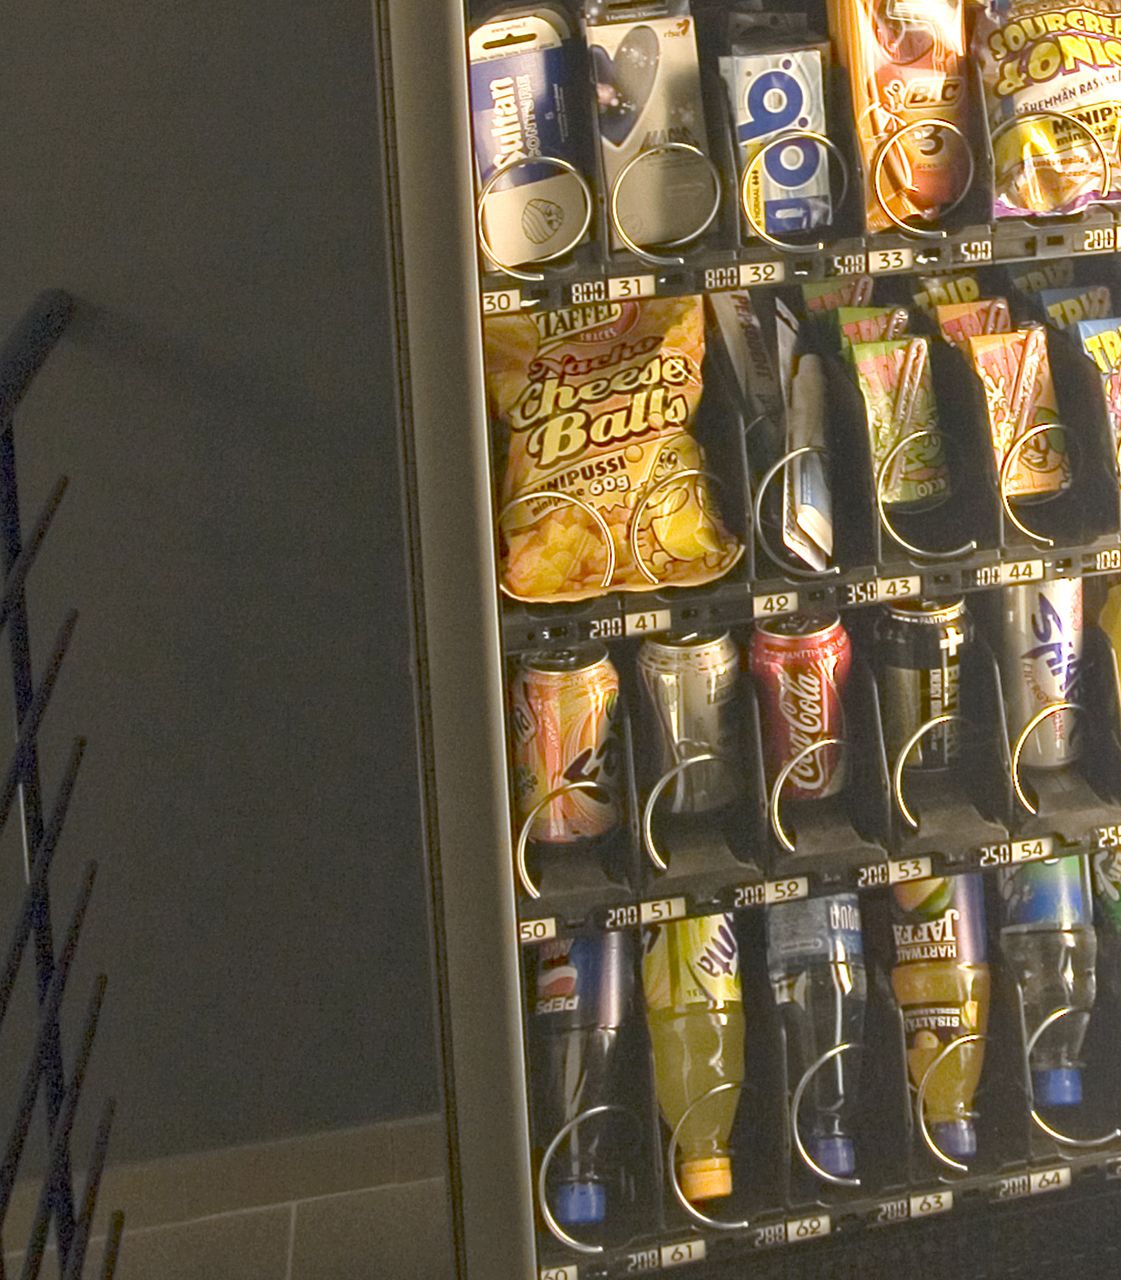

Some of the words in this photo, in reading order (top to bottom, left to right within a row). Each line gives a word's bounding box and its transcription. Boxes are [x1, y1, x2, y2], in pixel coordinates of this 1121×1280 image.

[920, 123, 945, 157] 3
[1084, 228, 1114, 250] 200
[878, 252, 904, 268] 33
[749, 264, 776, 282] 32
[620, 278, 643, 296] 31
[483, 292, 510, 311] 30
[528, 336, 664, 381] Nacho
[527, 386, 688, 468] Balls
[588, 474, 631, 496] 60g
[1009, 564, 1034, 578] 44
[885, 579, 911, 596] 43
[762, 596, 789, 613] 42
[590, 618, 621, 638] 200
[635, 613, 659, 630] 41
[979, 842, 1011, 867] 250
[1021, 842, 1043, 858] 54
[858, 863, 888, 887] 200
[898, 861, 922, 877] 53
[735, 886, 766, 907] 200
[773, 881, 799, 897] 52
[606, 905, 637, 928] 200
[651, 903, 674, 919] 51
[521, 922, 547, 940] 50
[1037, 1171, 1061, 1189] 64
[919, 1194, 944, 1212] 63
[796, 1220, 821, 1237] 62
[671, 1245, 694, 1261] 61
